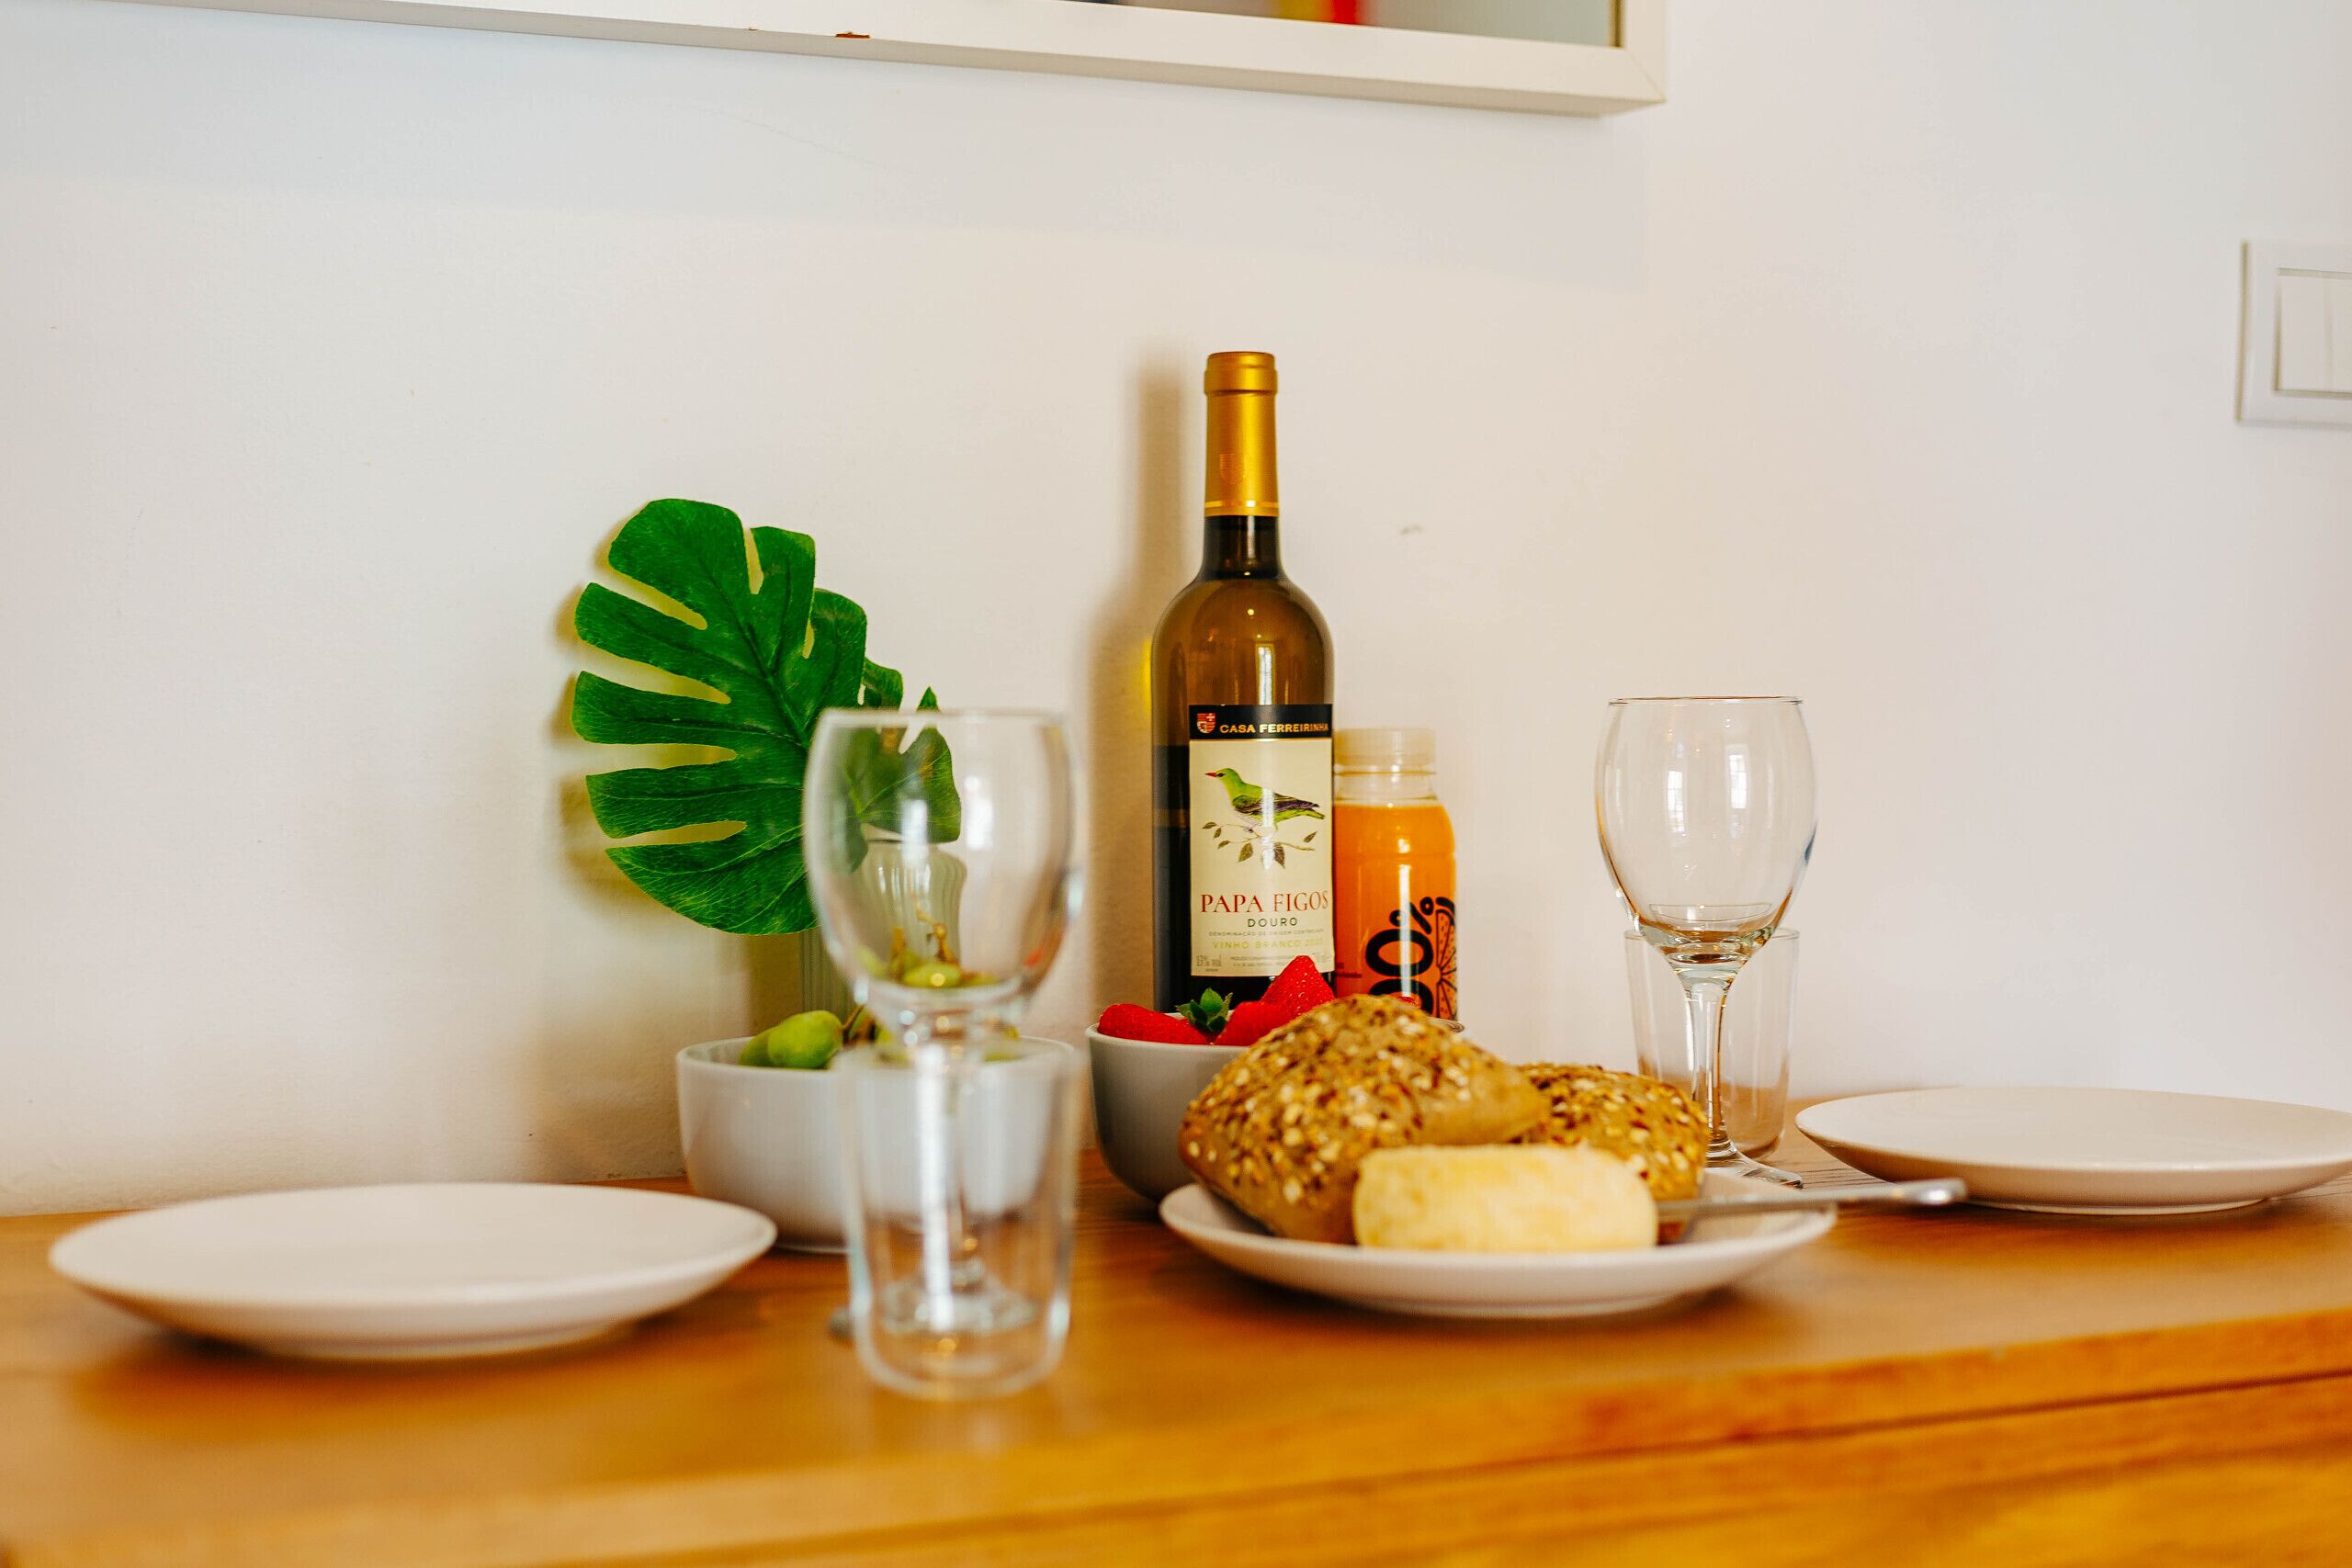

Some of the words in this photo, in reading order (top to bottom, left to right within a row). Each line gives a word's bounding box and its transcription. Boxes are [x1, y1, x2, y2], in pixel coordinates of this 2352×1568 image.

[1219, 723, 1256, 734] CASA
[1259, 722, 1329, 733] FERREIRINHA
[1200, 894, 1264, 913] PAPA
[1273, 890, 1329, 912] FIGOS
[1247, 917, 1298, 928] DOURO
[1212, 941, 1250, 949] VINHO
[1255, 939, 1301, 949] BRANCO
